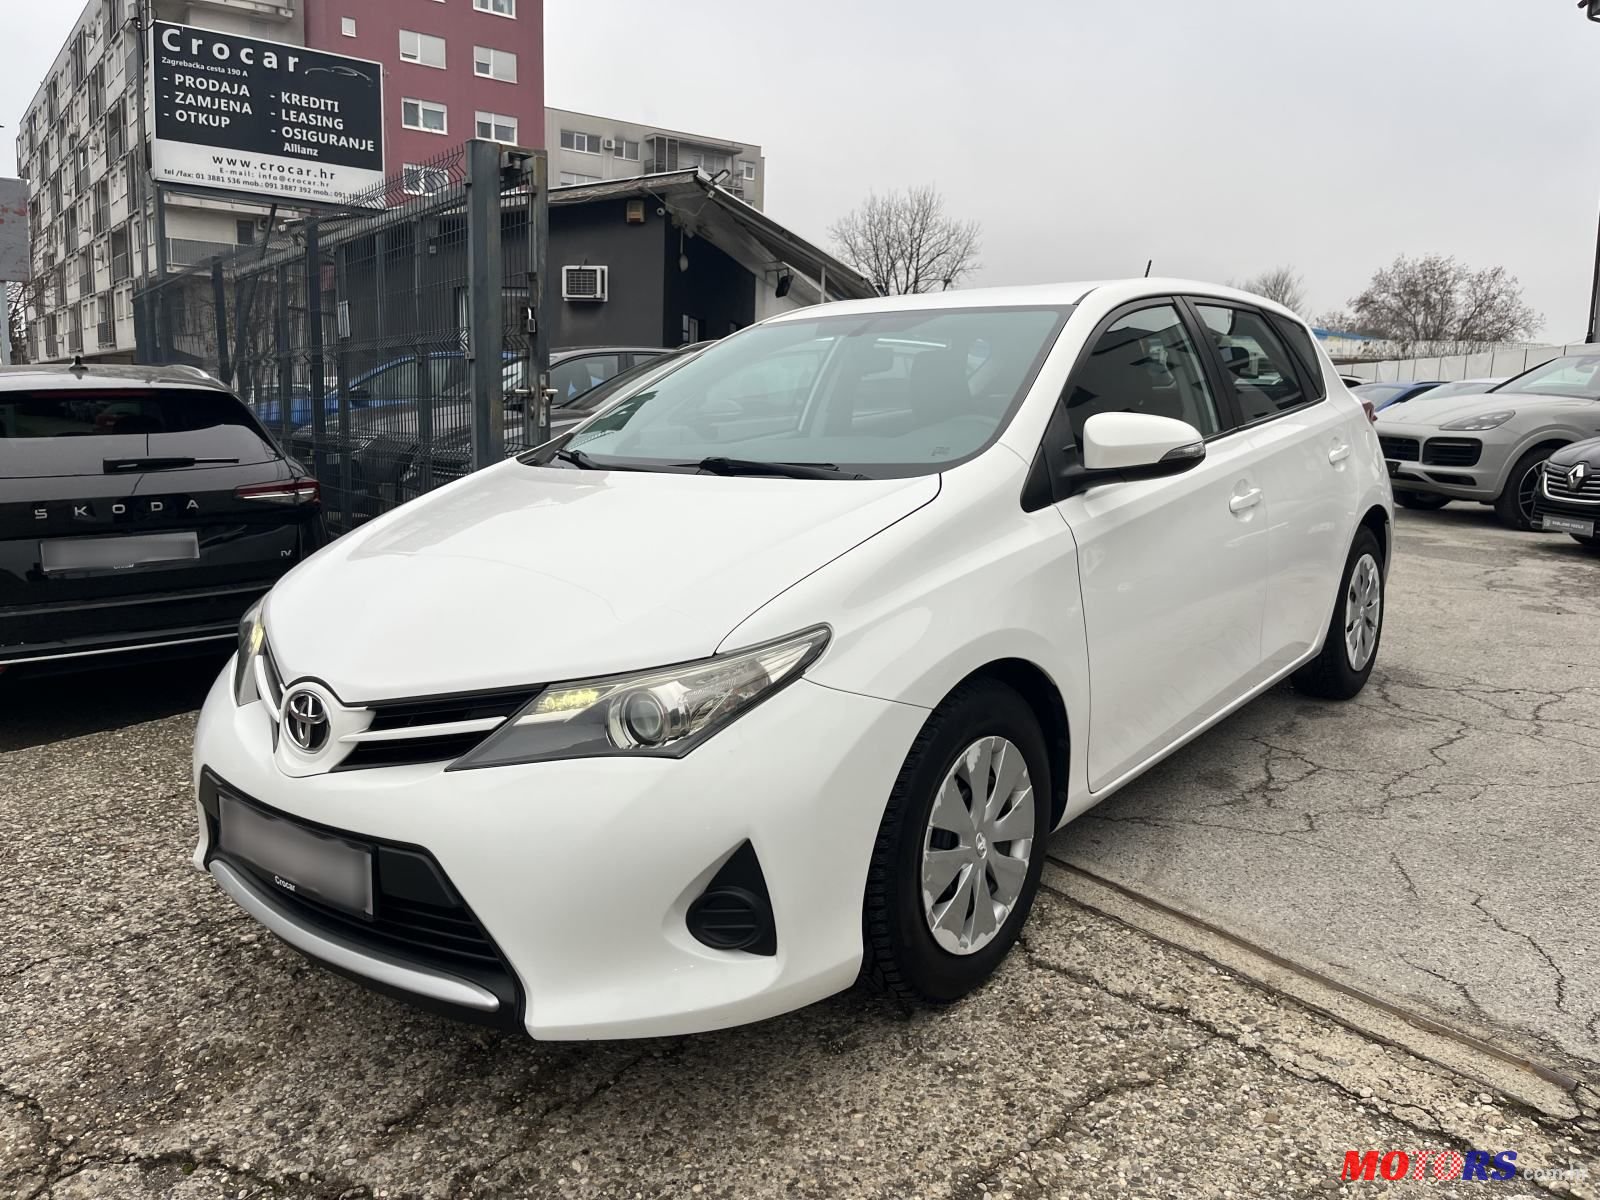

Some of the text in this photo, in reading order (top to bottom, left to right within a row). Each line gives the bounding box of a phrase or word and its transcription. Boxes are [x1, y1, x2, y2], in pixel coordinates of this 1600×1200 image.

[162, 29, 299, 73] Crocar
[206, 65, 225, 74] cesta
[227, 67, 241, 76] 190
[242, 70, 249, 78] A
[174, 73, 251, 98] PRODAJA
[174, 91, 253, 115] ZAMJENA
[281, 91, 340, 113] KREDITI
[175, 109, 231, 128] OTKUP
[281, 108, 344, 130] LEASING
[281, 126, 375, 152] OSIGURANJE
[283, 142, 319, 157] Allianz
[212, 155, 336, 180] www.crocar.hr
[34, 499, 199, 519] SKODA
[274, 875, 296, 892] Crocar
